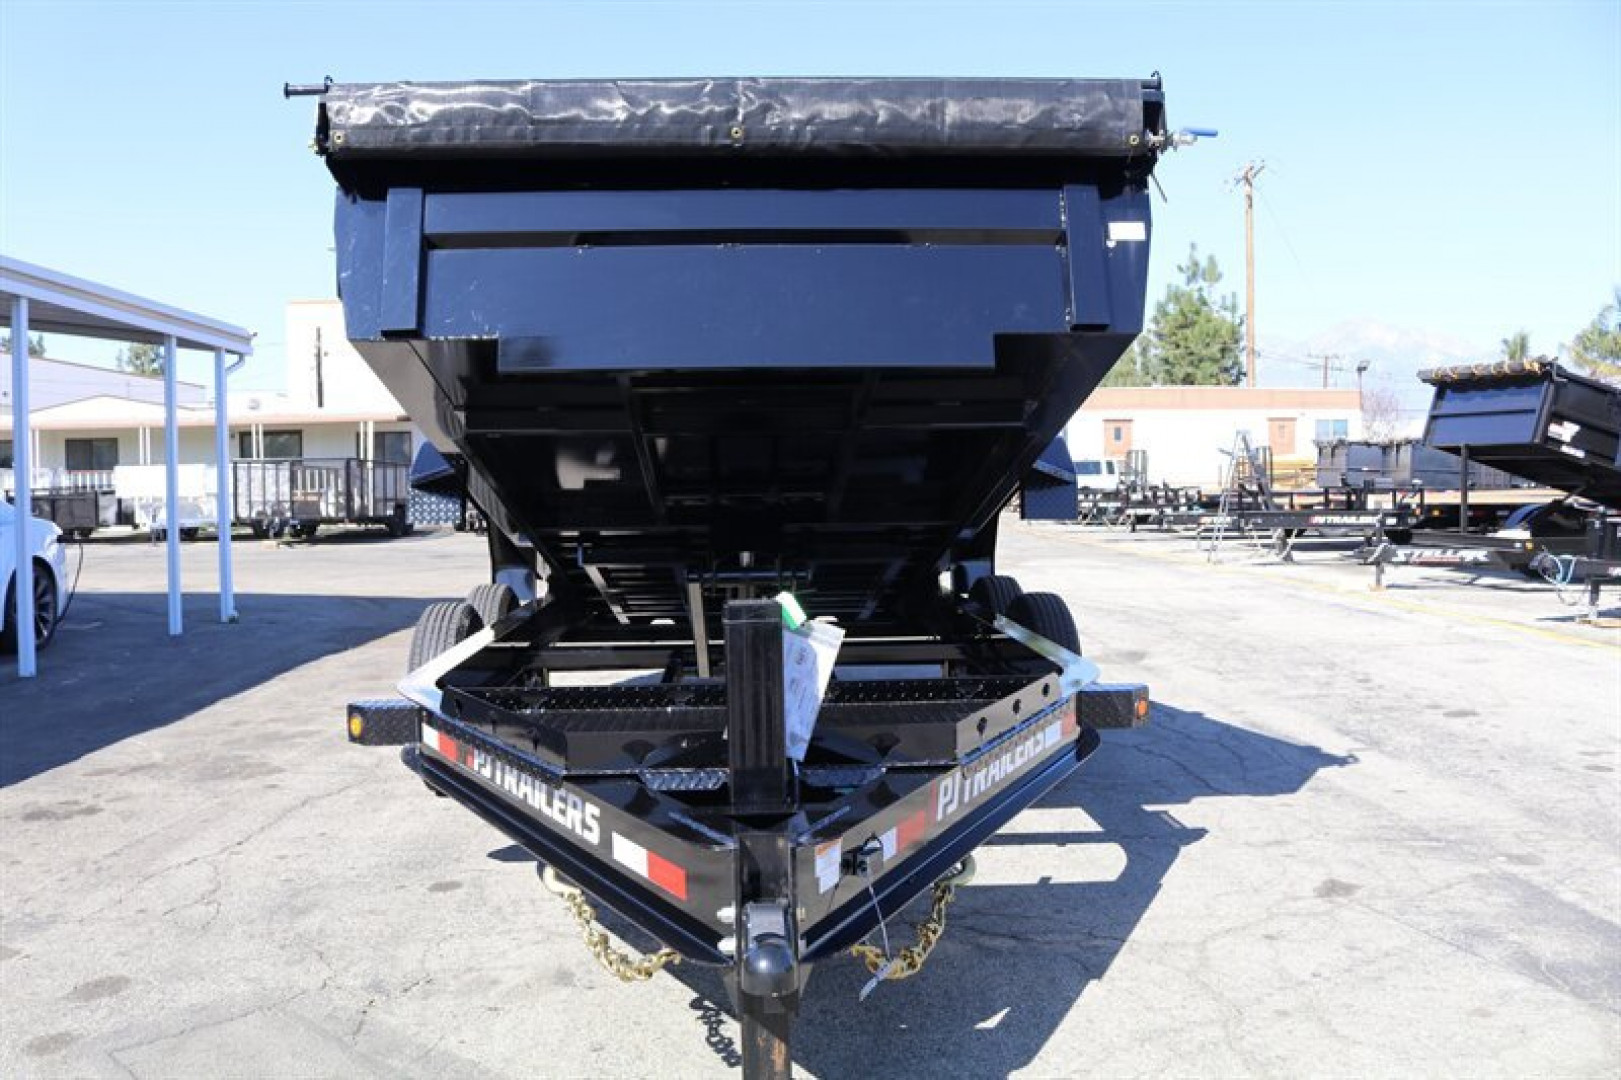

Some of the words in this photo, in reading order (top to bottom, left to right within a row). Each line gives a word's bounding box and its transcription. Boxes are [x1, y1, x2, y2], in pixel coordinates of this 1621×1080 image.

[473, 749, 492, 779] PJ
[494, 760, 600, 845] TRAILERS
[937, 771, 961, 821] PJ
[962, 731, 1045, 804] TRAILERS
